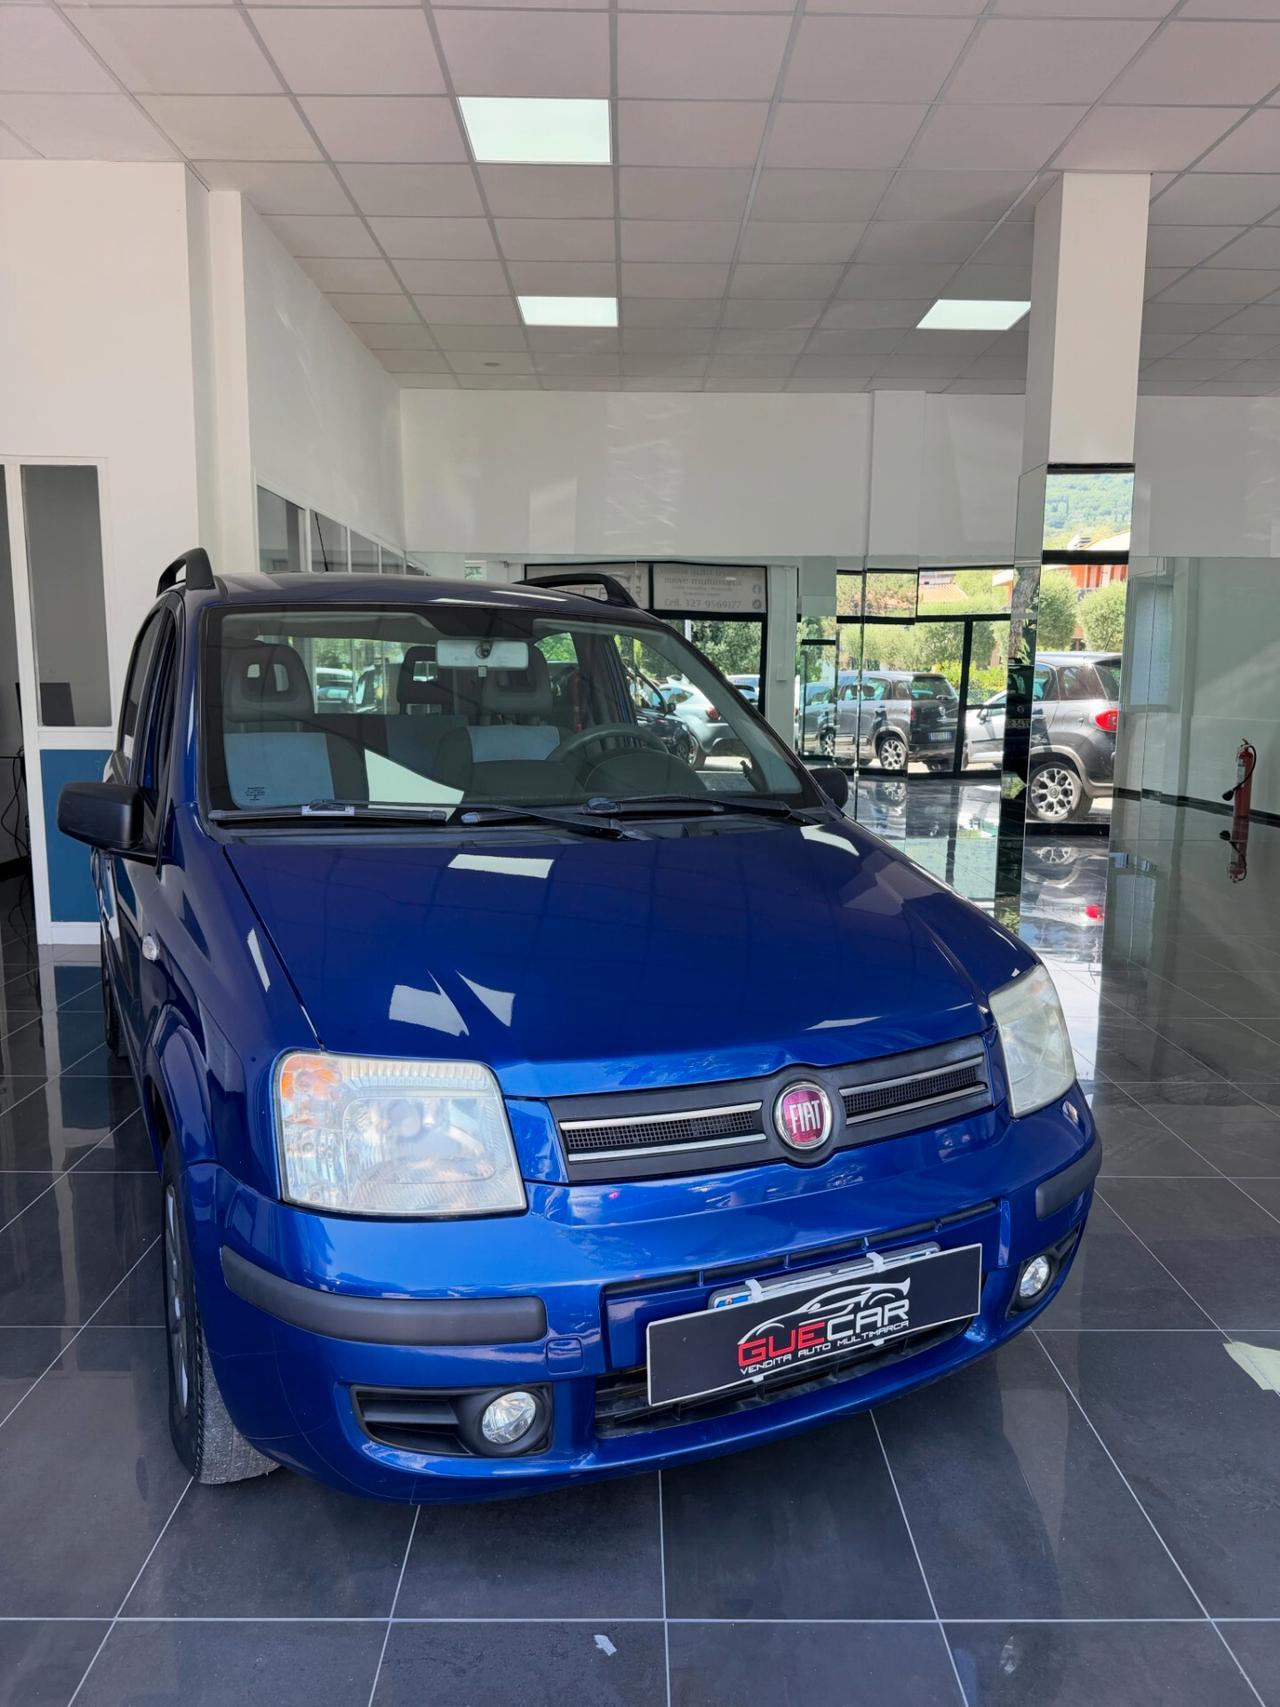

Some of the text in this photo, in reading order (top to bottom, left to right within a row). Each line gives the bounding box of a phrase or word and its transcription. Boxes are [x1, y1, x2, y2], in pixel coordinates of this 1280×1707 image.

[686, 599, 702, 607] 327
[788, 1100, 820, 1135] FIAT
[737, 1299, 909, 1366] GUECAR
[740, 1320, 909, 1375] VENDITA AUTO MULTIMARCA
